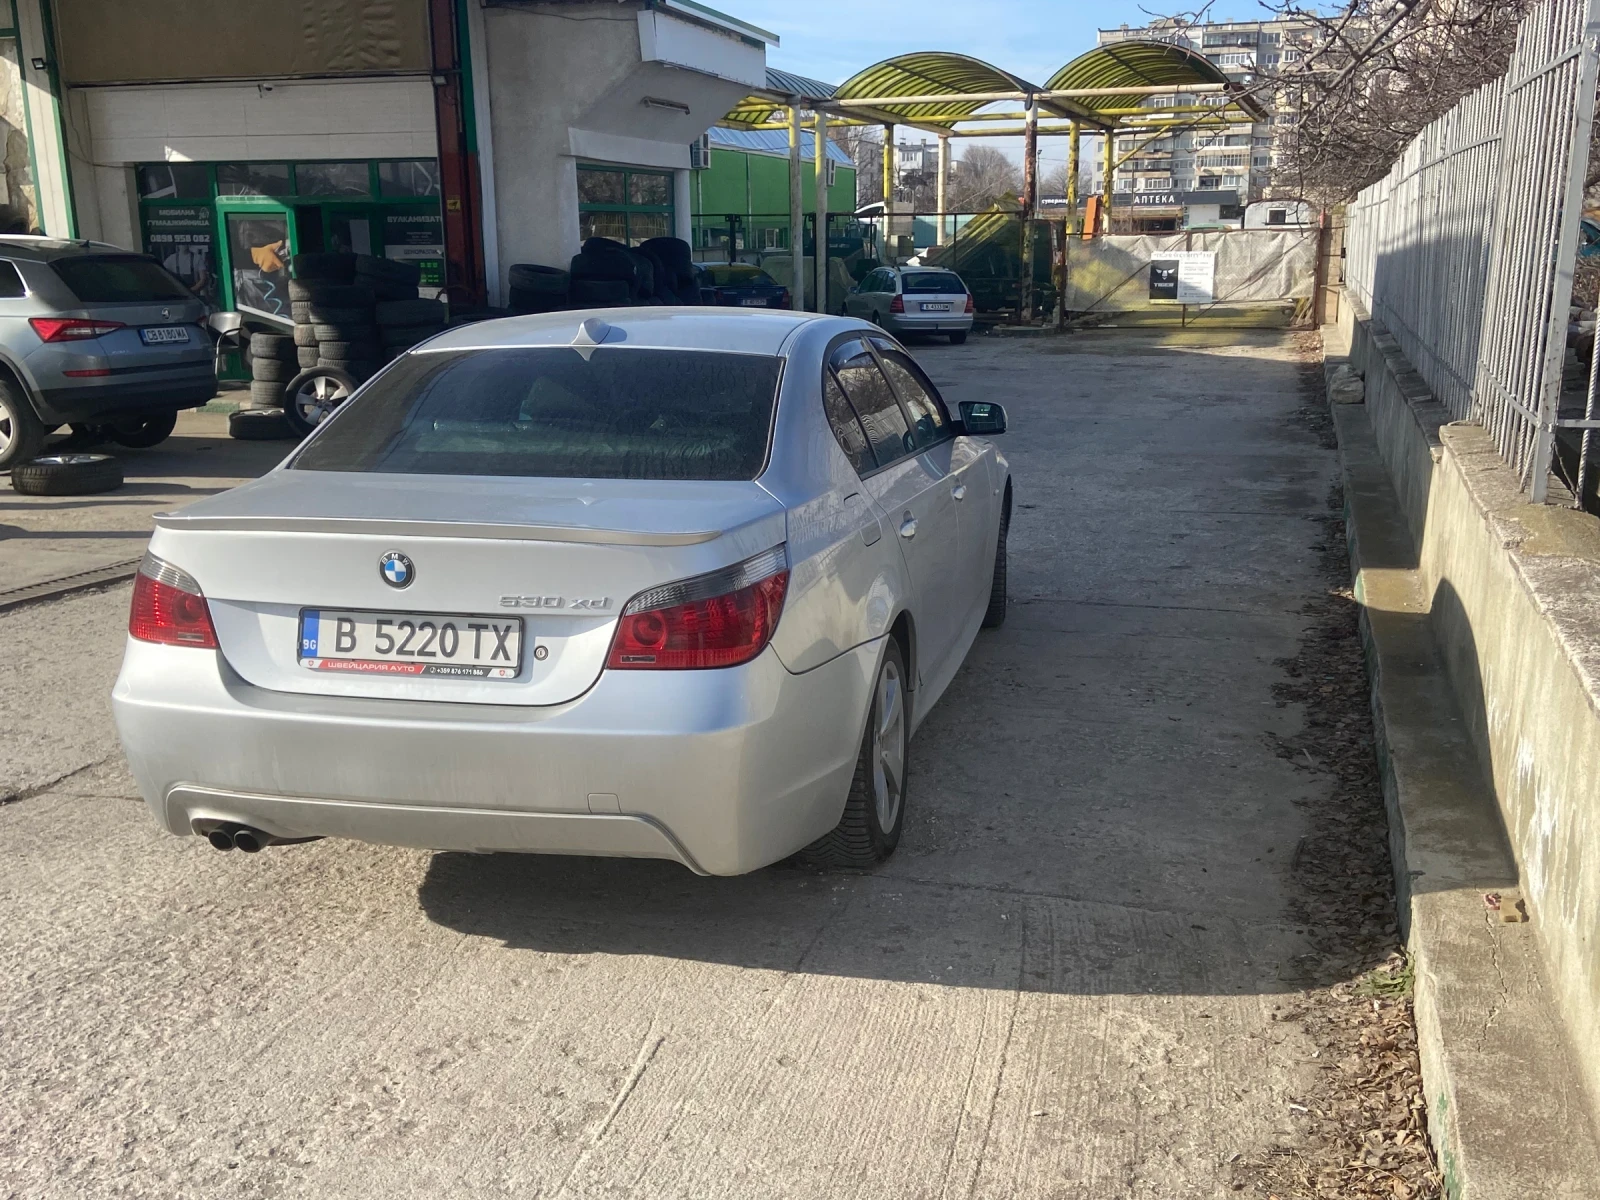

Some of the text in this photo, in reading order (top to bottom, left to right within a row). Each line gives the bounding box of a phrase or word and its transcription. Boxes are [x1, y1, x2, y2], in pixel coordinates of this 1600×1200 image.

[1133, 195, 1175, 204] АПТЕКА
[147, 330, 159, 341] CB
[158, 329, 177, 340] 8180
[381, 553, 410, 566] BMW
[499, 595, 610, 610] 530 xd
[302, 639, 317, 650] BG
[335, 617, 512, 661] B 5220 TX
[327, 661, 415, 673] ШВЕЙЦАРИЯ АУТО
[436, 667, 451, 675] +359
[462, 668, 472, 676] 171
